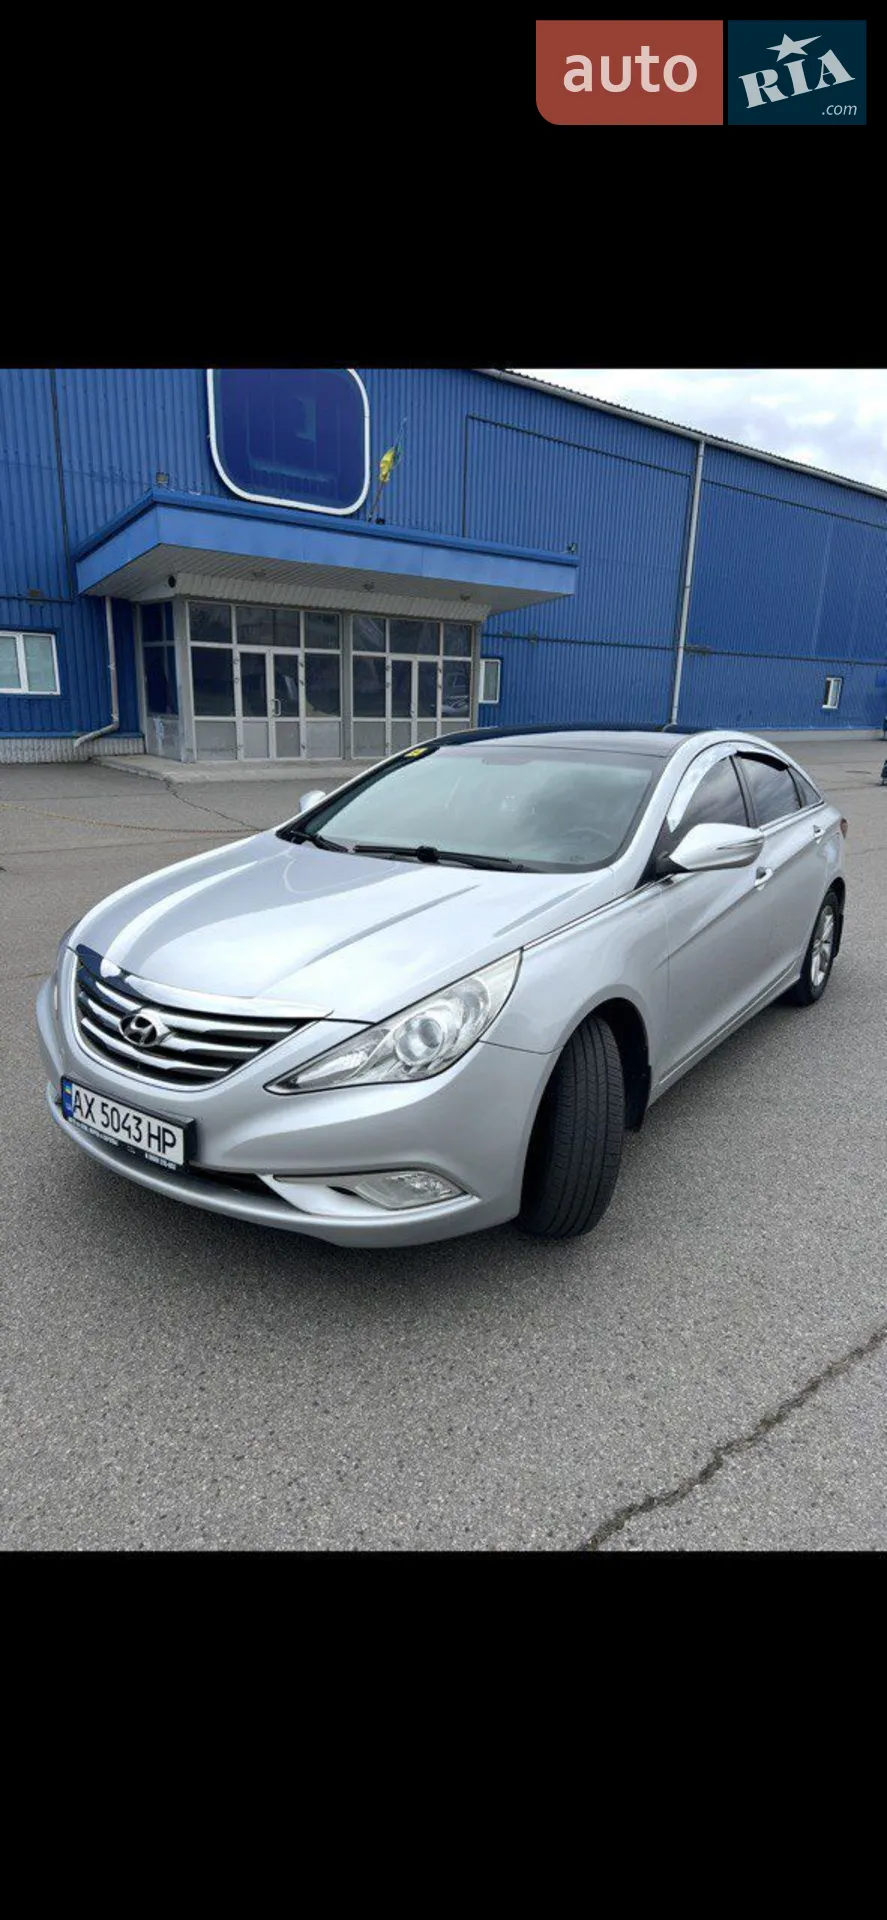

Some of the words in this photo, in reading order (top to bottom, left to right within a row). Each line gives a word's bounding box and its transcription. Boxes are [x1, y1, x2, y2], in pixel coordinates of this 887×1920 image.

[73, 1090, 96, 1123] AX
[101, 1102, 142, 1143] 5043
[147, 1121, 176, 1154] HP
